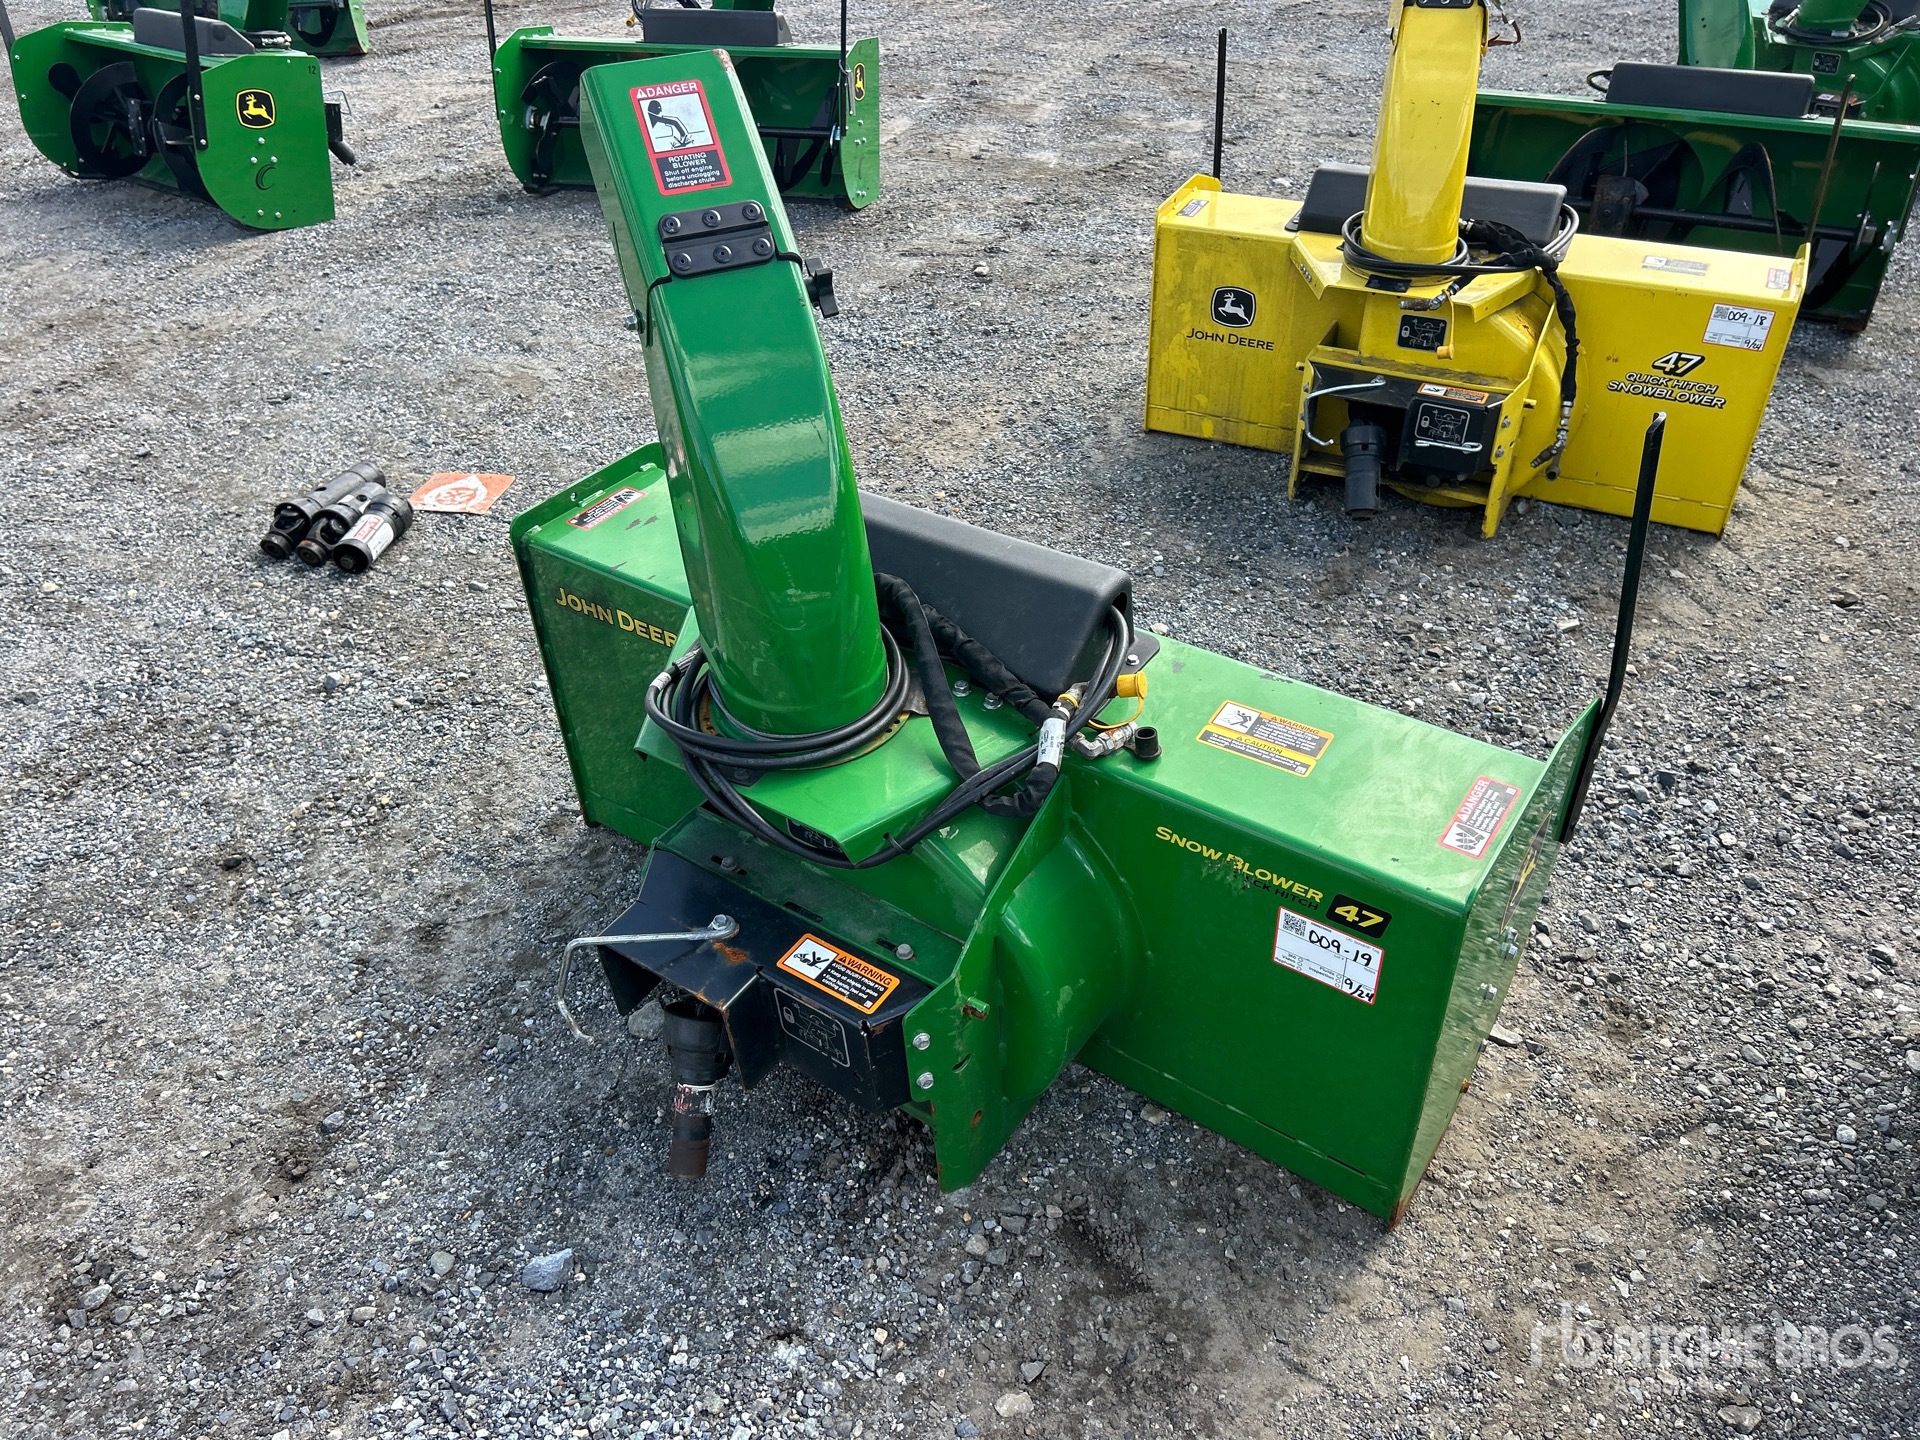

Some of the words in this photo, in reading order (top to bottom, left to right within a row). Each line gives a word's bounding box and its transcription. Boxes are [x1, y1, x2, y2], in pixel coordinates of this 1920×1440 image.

[646, 82, 698, 97] DANGER
[668, 152, 707, 163] ROTATING
[672, 159, 707, 169] BLOWER
[691, 165, 713, 173] engine
[666, 174, 686, 182] before
[687, 170, 720, 179] unclogging
[668, 179, 698, 189] discharge
[1186, 328, 1225, 343] JOHN
[1228, 333, 1275, 351] DEERE
[1652, 352, 1704, 376] 47
[1607, 380, 1726, 408] SNOWBLOWER
[1625, 372, 1671, 387] QUICK
[1672, 379, 1719, 395] HITCH
[556, 587, 614, 625] JOHN
[616, 609, 678, 648] DEER
[1280, 718, 1320, 736] WARNING
[1242, 738, 1283, 754] CAUTION
[1460, 779, 1490, 816] DANGER
[1155, 826, 1223, 860] SNOW
[1226, 853, 1324, 903] BLOWER
[1275, 888, 1319, 911] HITCH
[1334, 905, 1384, 928] 47
[832, 961, 847, 972] AVOID
[846, 969, 862, 980] INJURY
[861, 976, 875, 987] FROM
[874, 983, 885, 992] PTO
[845, 958, 893, 986] WARNING
